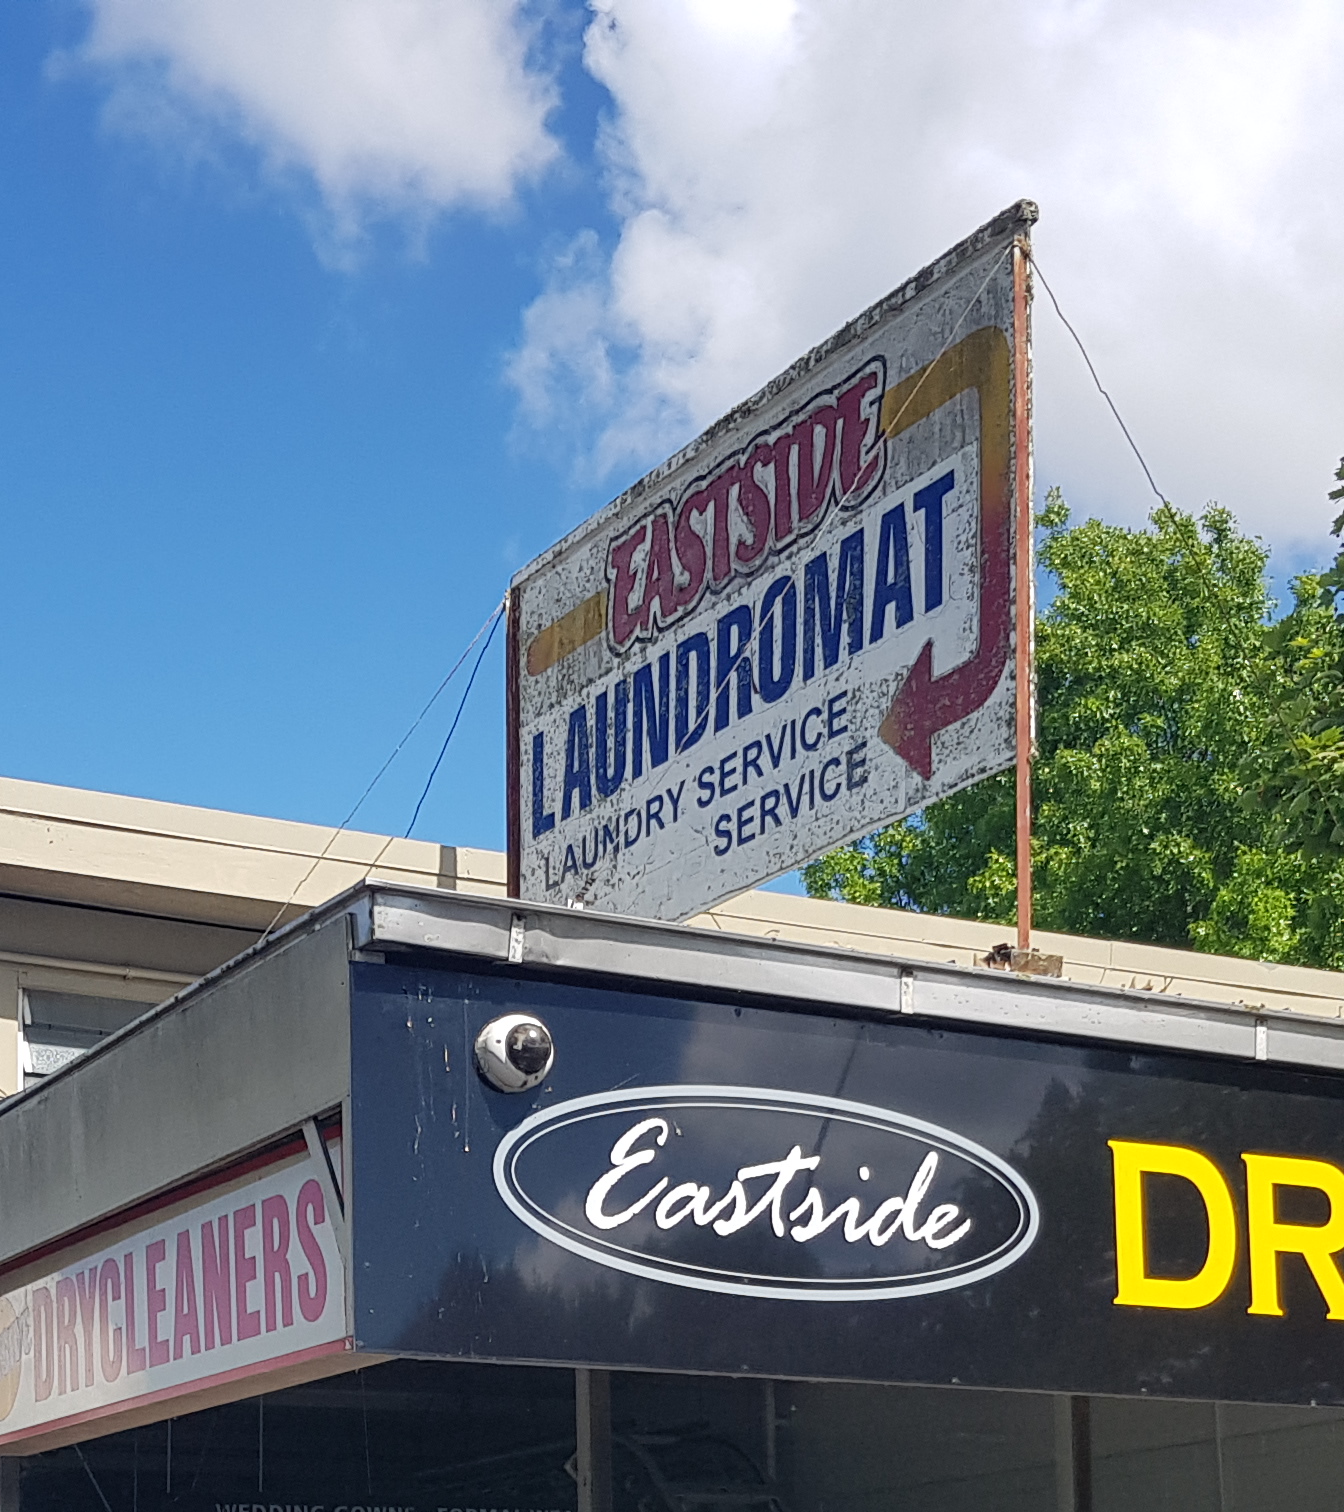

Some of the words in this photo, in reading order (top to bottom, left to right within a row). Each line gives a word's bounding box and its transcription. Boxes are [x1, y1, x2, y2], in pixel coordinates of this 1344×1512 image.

[611, 371, 879, 646] EASTSIDE
[532, 469, 955, 840] LAUNDROMAT
[544, 779, 686, 893] LAUNDRY
[697, 690, 849, 810] SERVICE
[713, 740, 869, 858] SERVICE
[32, 1178, 329, 1404] DRYCLEANERS
[585, 1118, 971, 1250] Eastside
